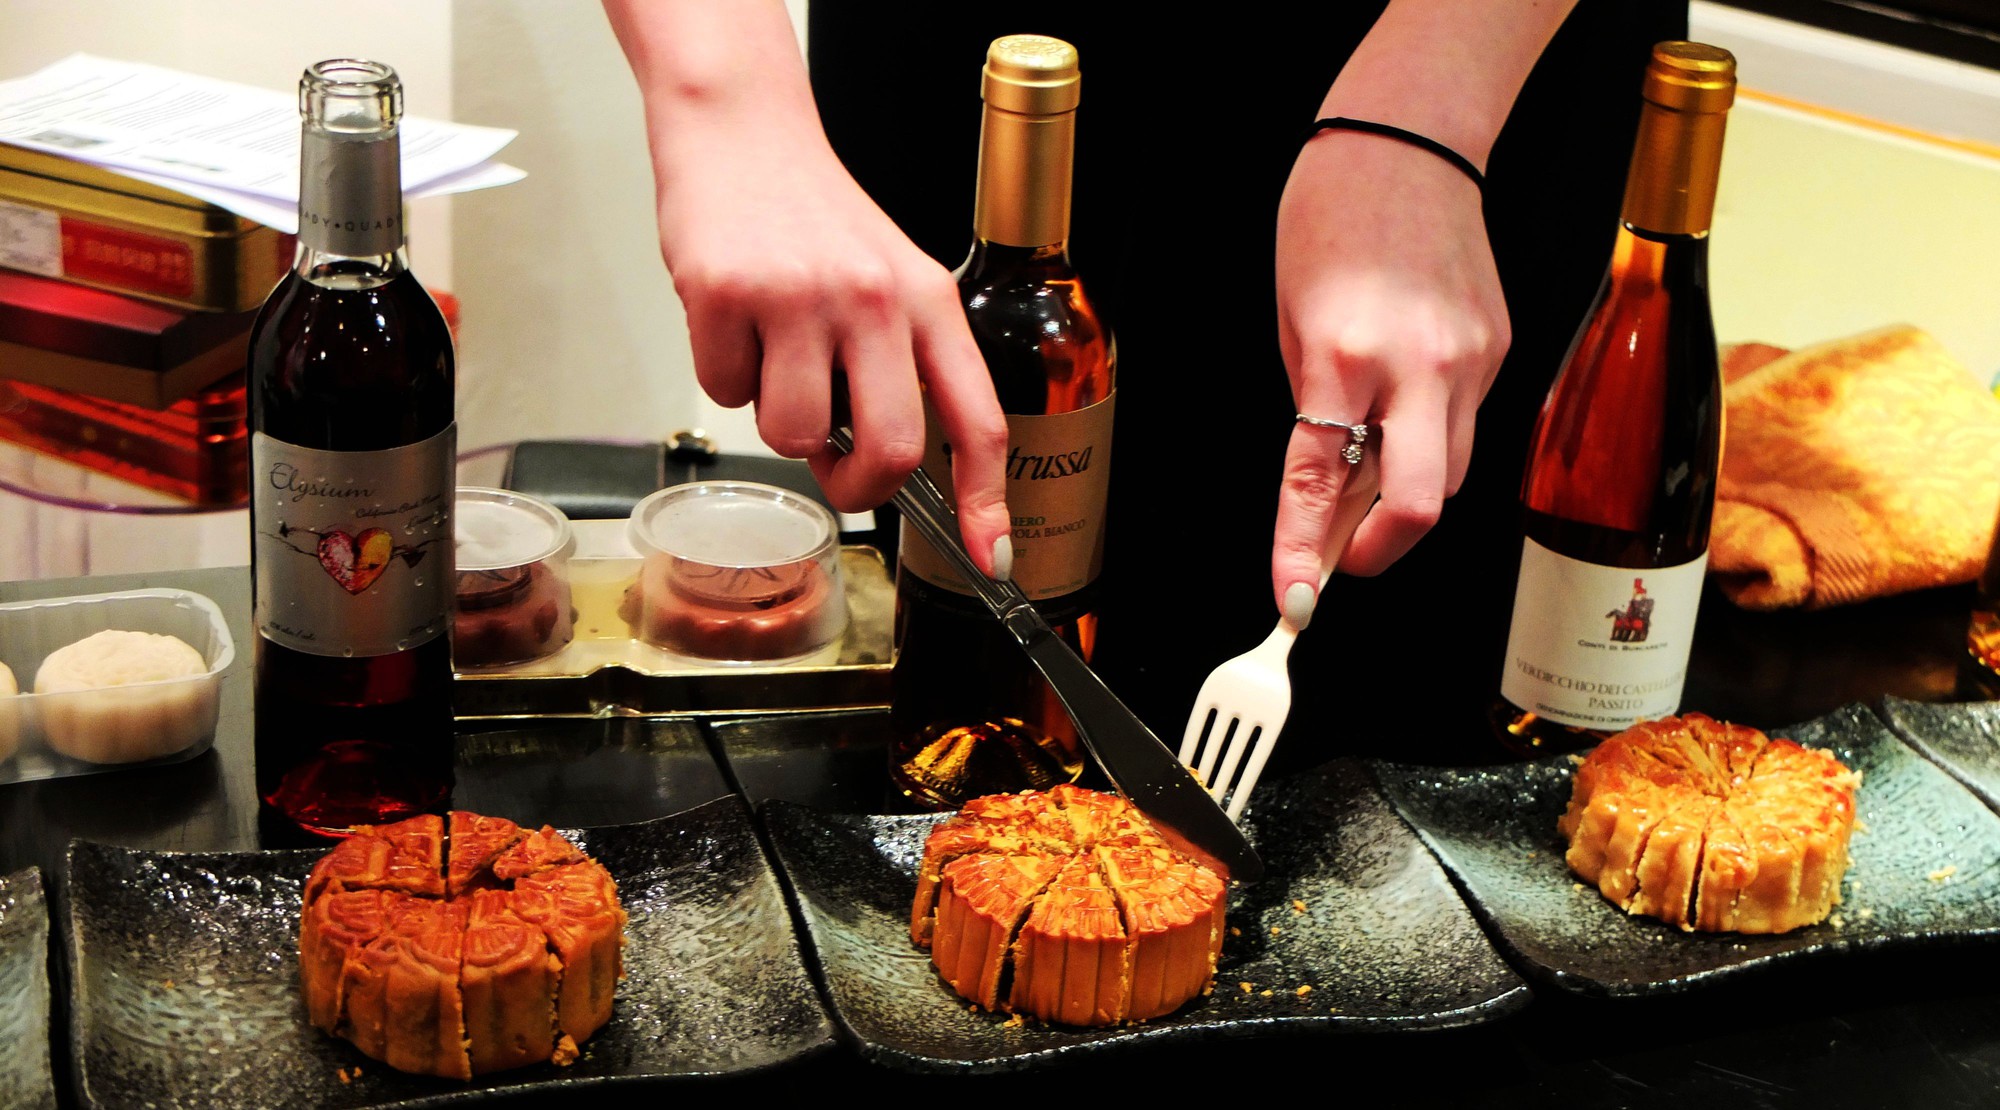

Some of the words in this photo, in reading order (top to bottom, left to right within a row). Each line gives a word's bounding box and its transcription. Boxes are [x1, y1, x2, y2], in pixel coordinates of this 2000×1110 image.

[299, 208, 330, 227] ADY
[270, 462, 376, 502] Elysium
[1044, 518, 1086, 537] BIANCO
[1516, 656, 1595, 694] VERDICCHIO
[1597, 682, 1620, 696] DEI
[1588, 696, 1643, 710] PASSITO
